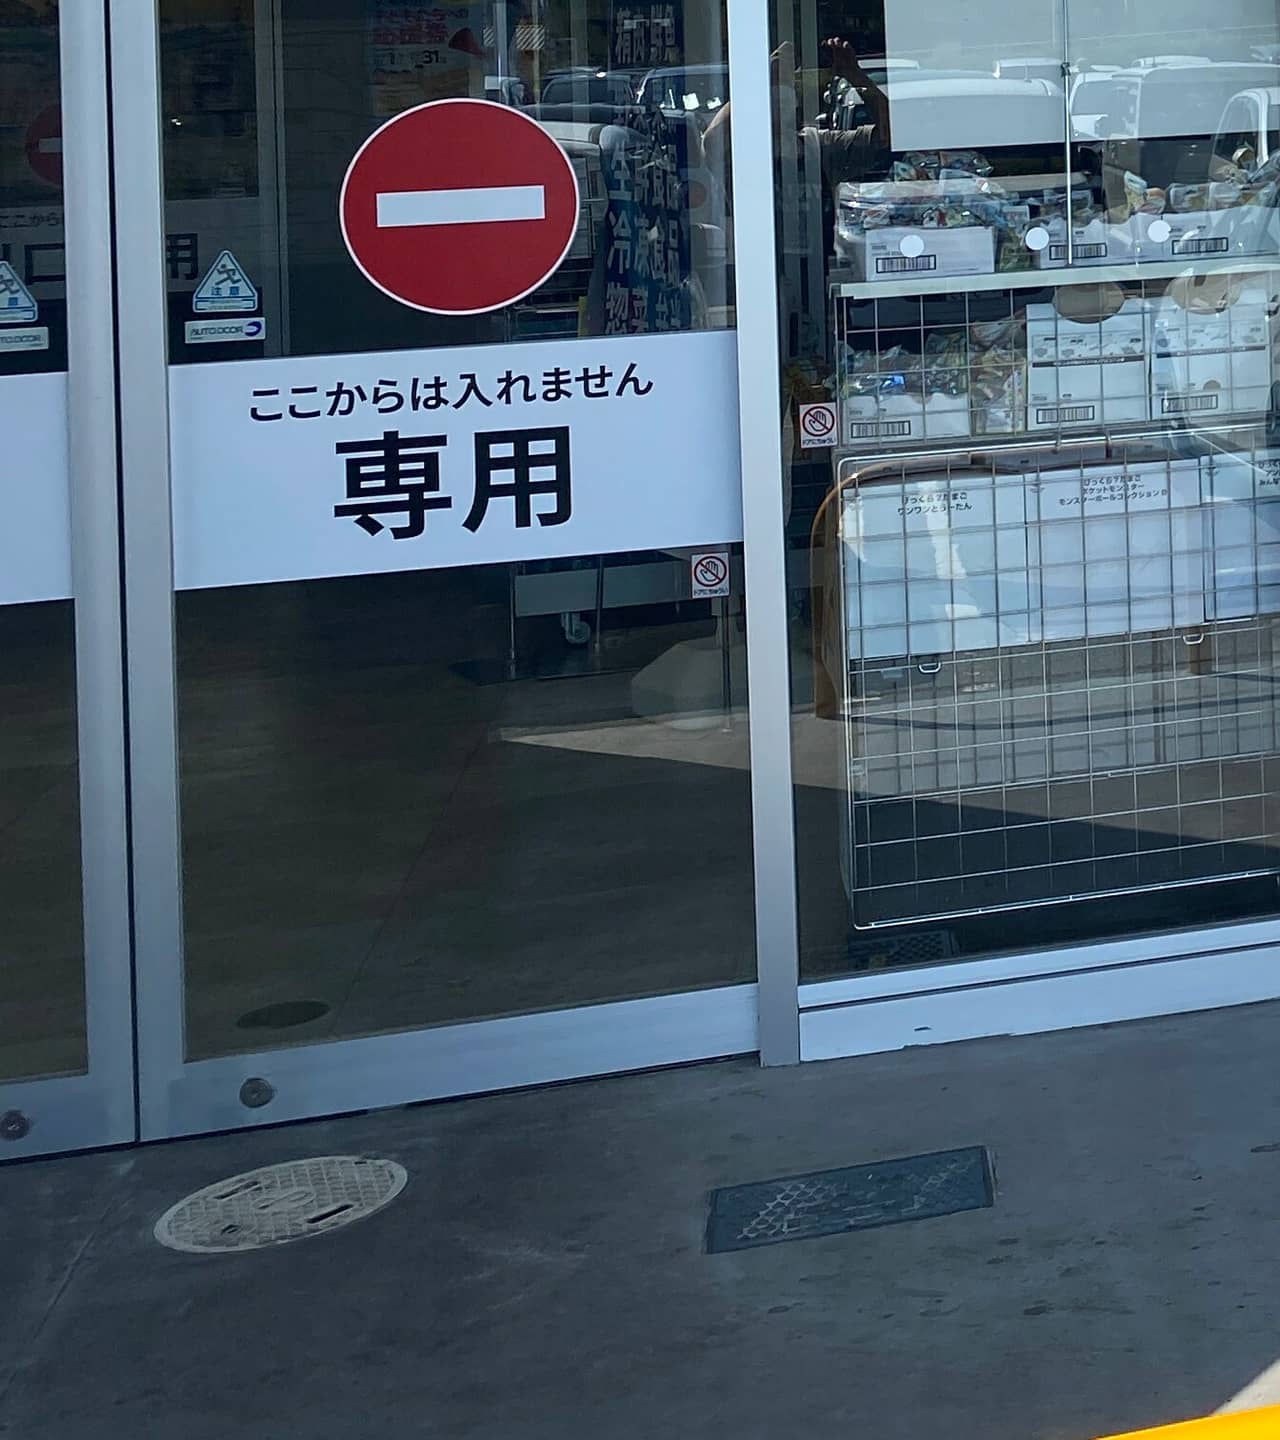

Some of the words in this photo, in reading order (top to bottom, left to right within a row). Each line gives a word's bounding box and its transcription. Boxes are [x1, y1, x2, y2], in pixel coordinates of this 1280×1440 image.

[248, 361, 655, 422] ここからは入れません
[333, 425, 573, 539] 専用
